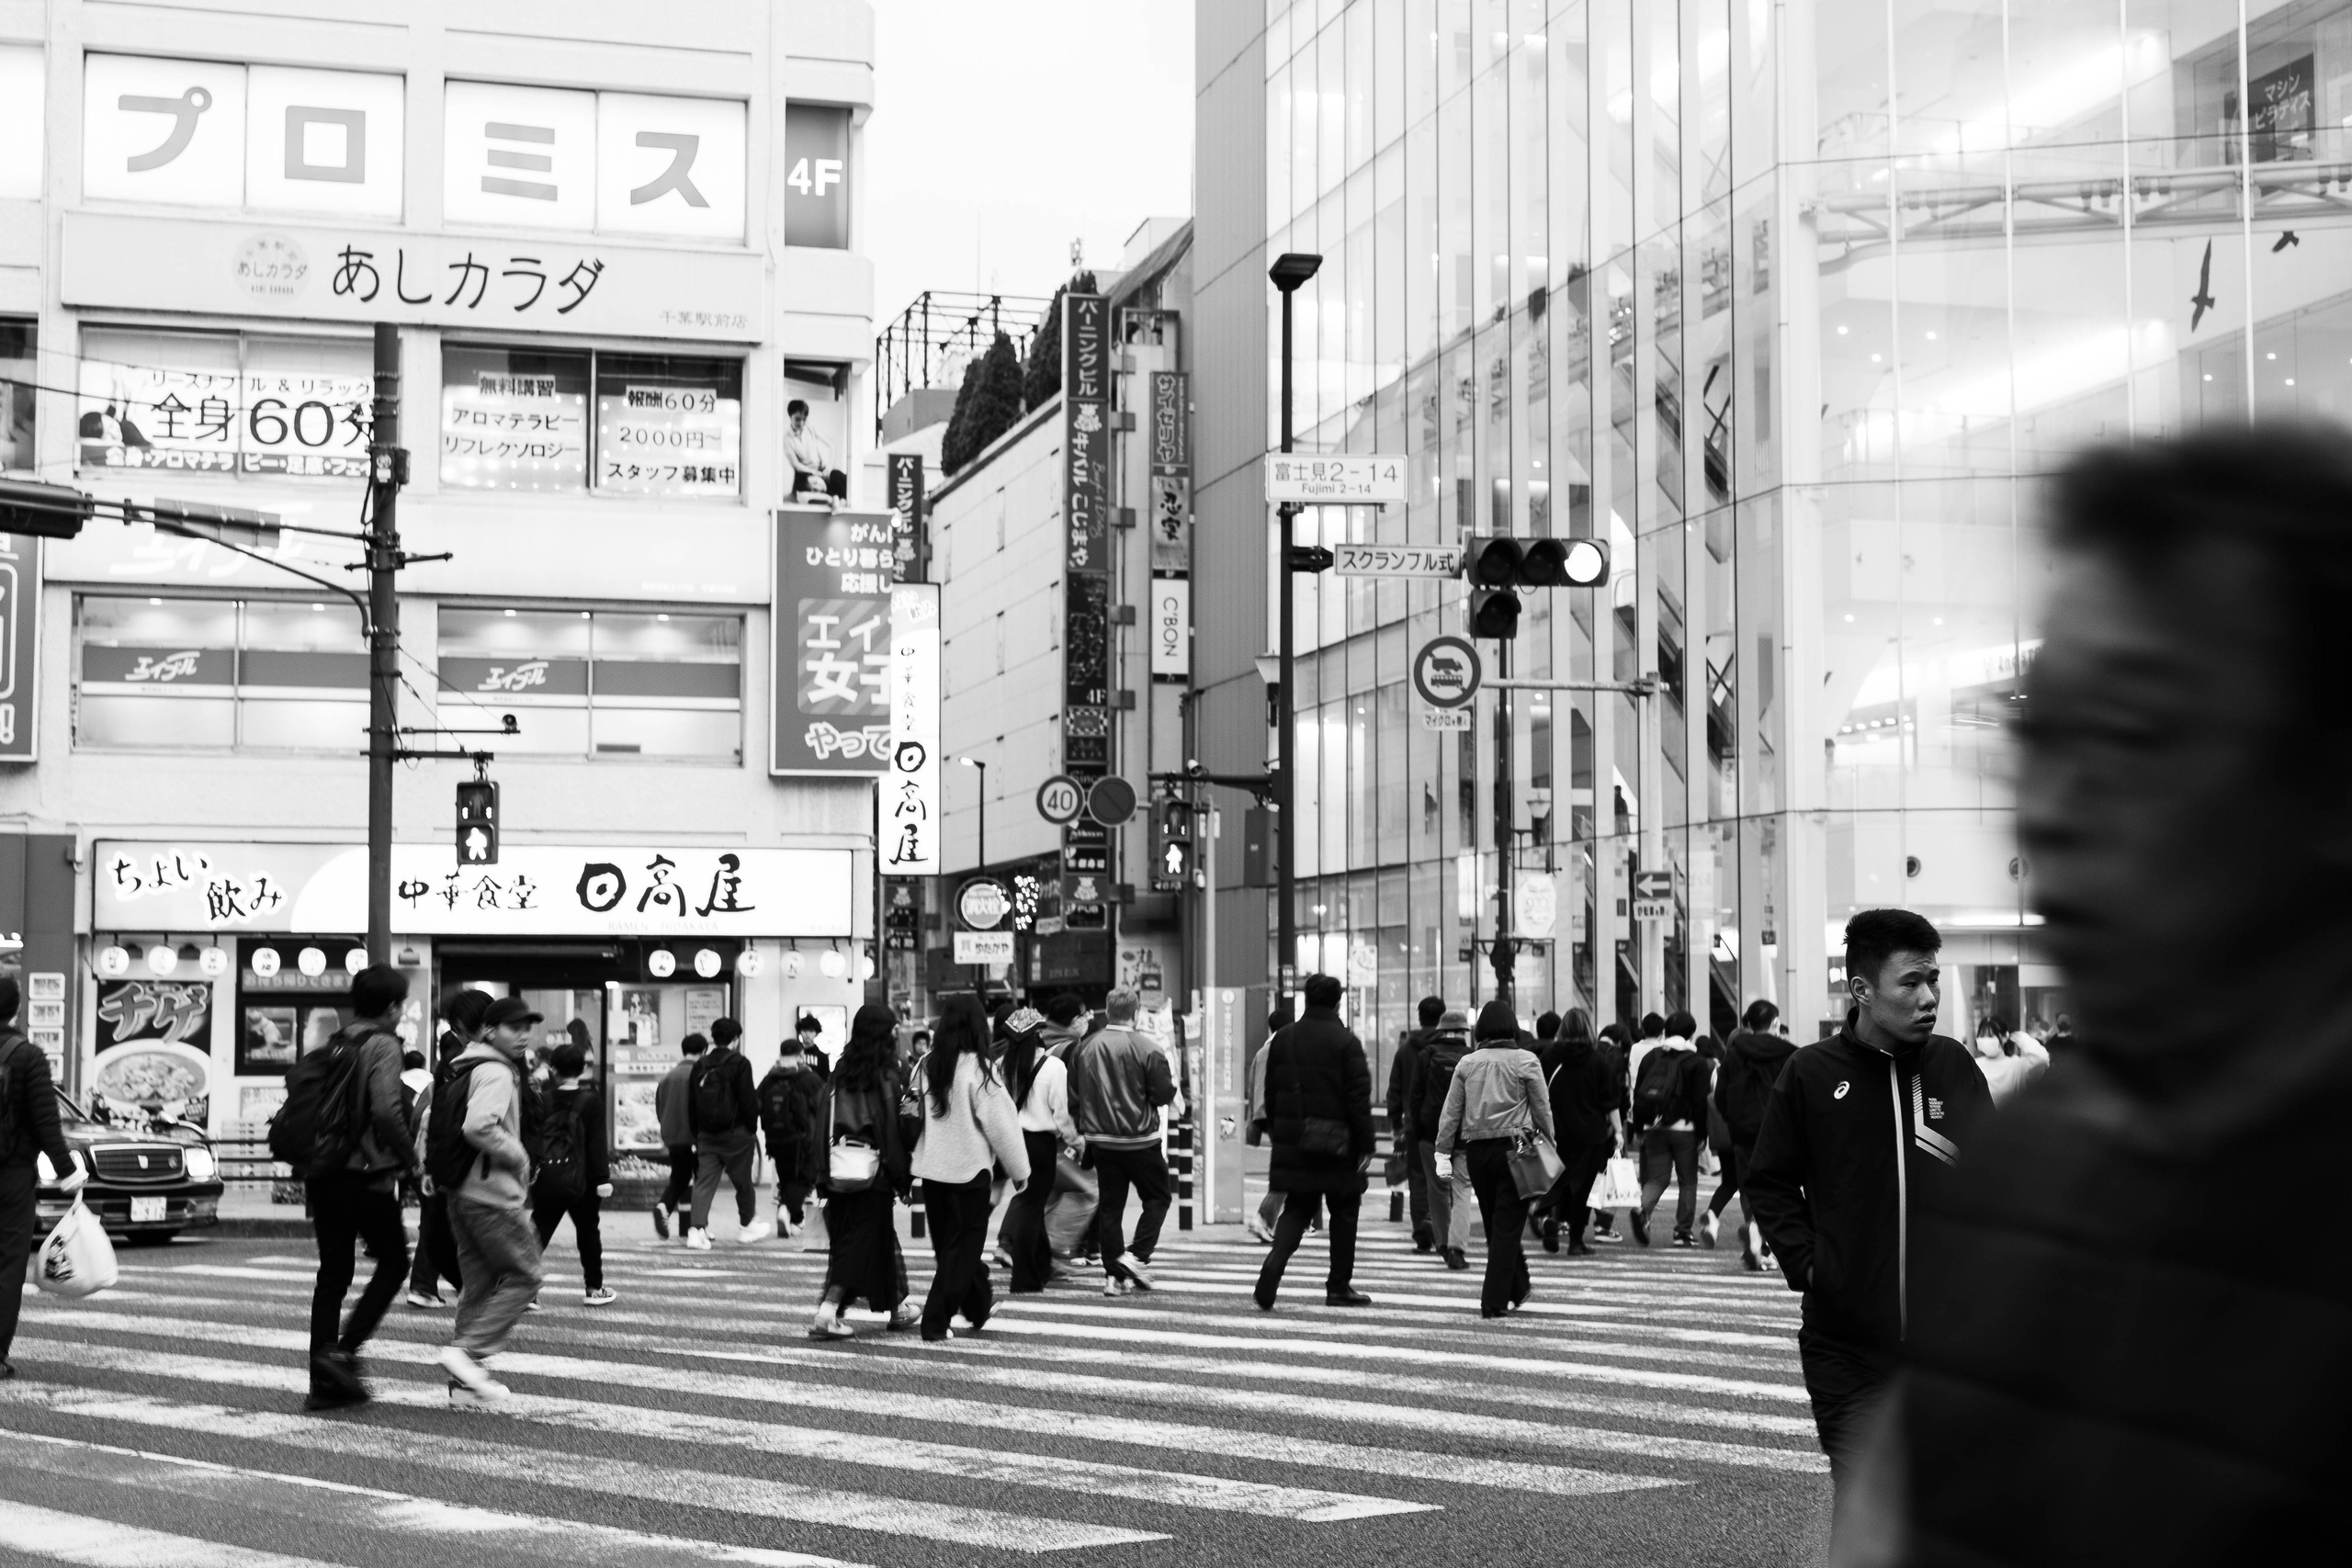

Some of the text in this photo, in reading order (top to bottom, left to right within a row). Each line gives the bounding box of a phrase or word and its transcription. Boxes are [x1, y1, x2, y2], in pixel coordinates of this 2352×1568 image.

[119, 86, 709, 208] プロミス
[787, 158, 842, 197] 4F
[237, 261, 308, 280] あしカラダ
[333, 243, 605, 314] あしカラダ
[659, 310, 747, 330] 千葉駅前店
[1078, 300, 1098, 396] バーニングビル
[278, 379, 290, 391] &
[479, 376, 554, 397] 無料講習
[453, 408, 580, 432] アロマテラピー
[445, 435, 581, 459] リフレクソロジー
[607, 462, 735, 486] スタッフ募集中
[1301, 483, 1372, 495] Fujimi 2-14
[1342, 550, 1454, 573] スクランブル式
[806, 615, 891, 653] エイ
[125, 651, 200, 682] エイブル
[478, 660, 549, 691] エイブル
[888, 740, 929, 864] 日高屋
[1046, 789, 1073, 812] 40
[113, 854, 209, 893] ちょい
[398, 852, 756, 917] 中華食堂 日高屋
[207, 877, 282, 920] 飲み
[608, 921, 719, 931] RAMEN HIDAKAYA
